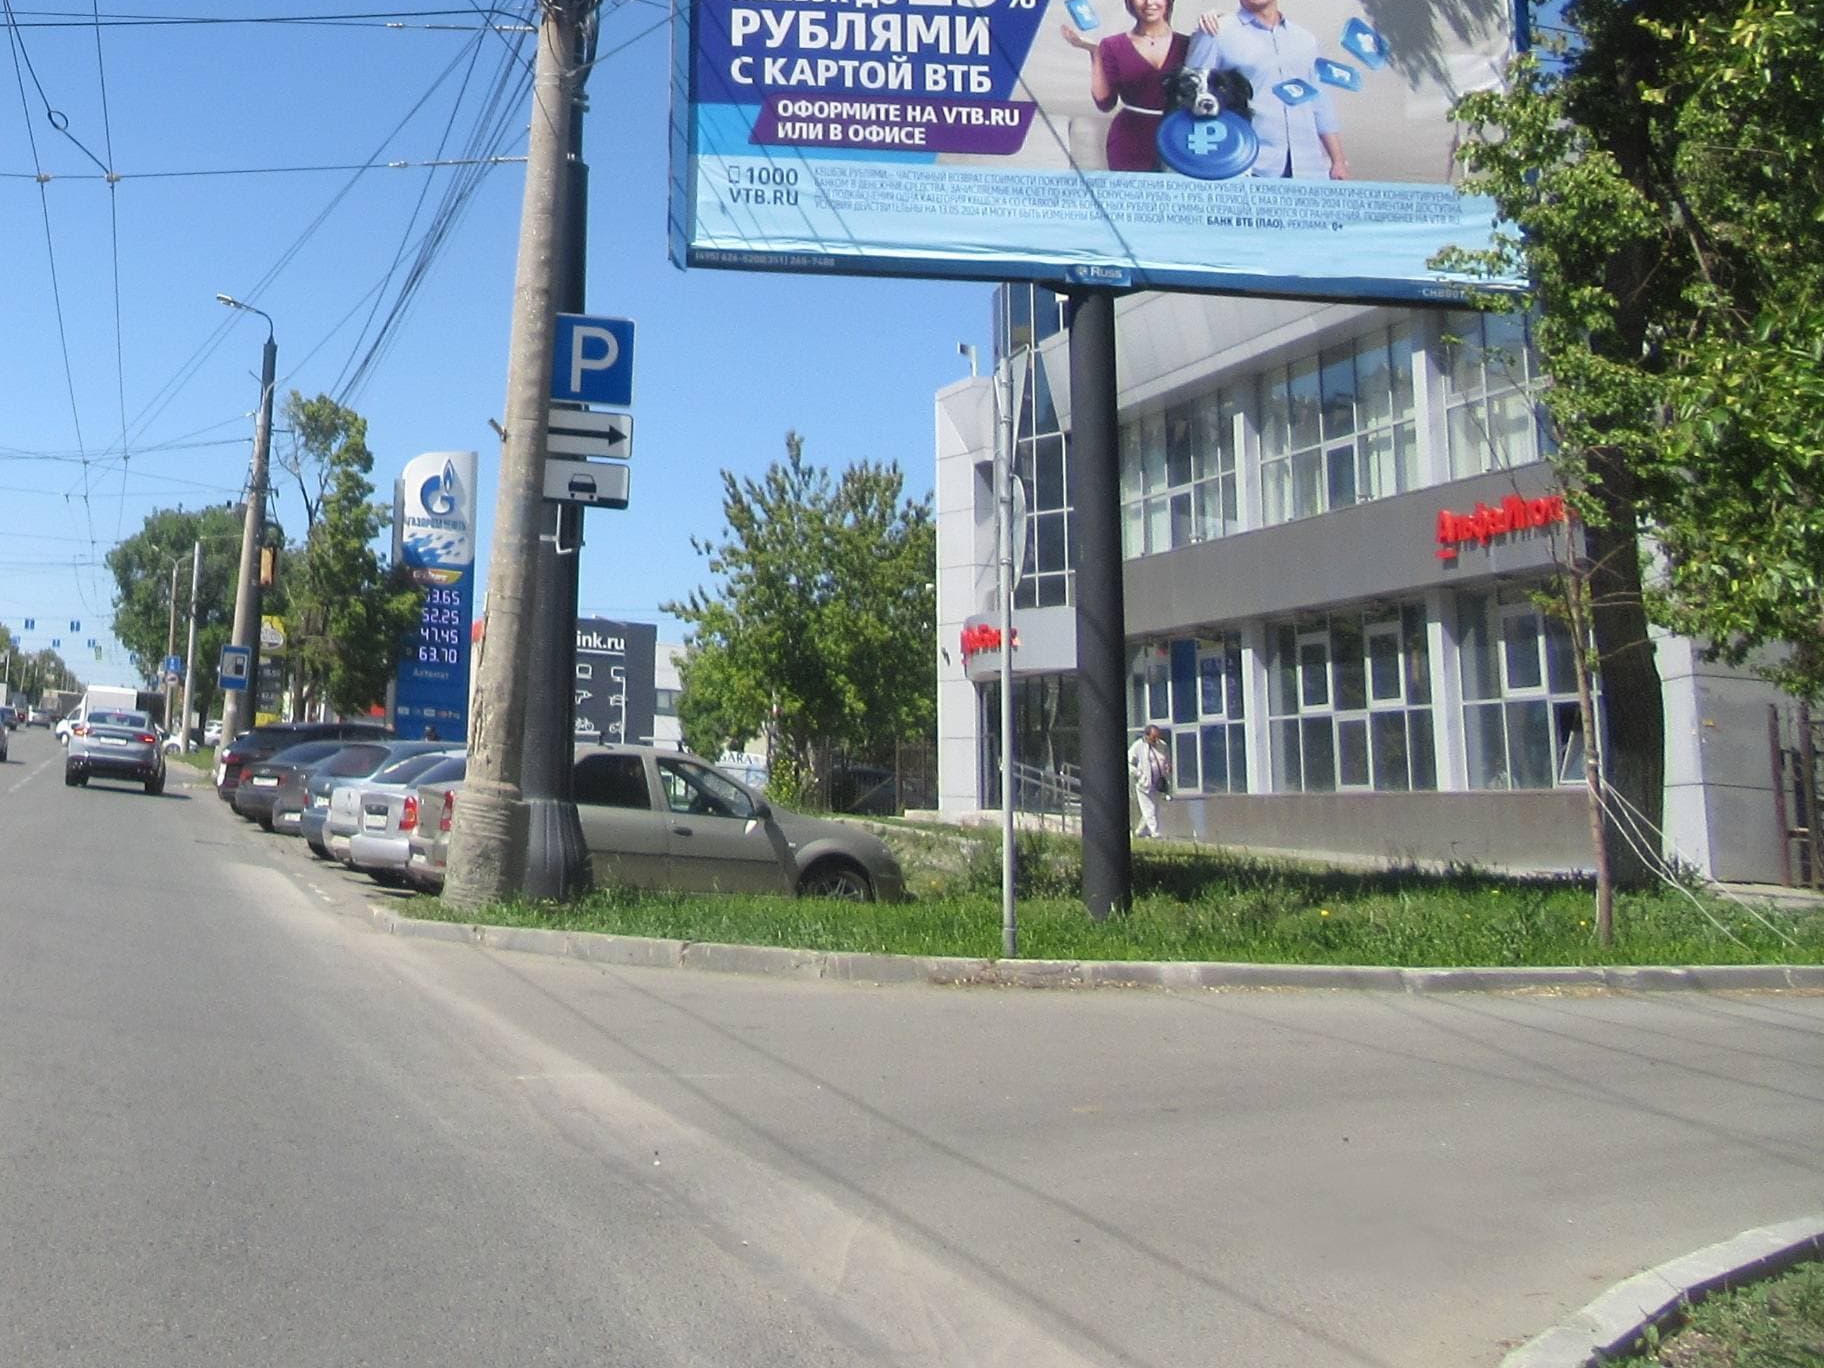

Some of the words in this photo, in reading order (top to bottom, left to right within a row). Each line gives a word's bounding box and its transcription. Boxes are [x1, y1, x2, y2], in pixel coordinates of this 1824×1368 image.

[731, 8, 990, 56] РУБЛЯМИ
[730, 56, 753, 84] С
[764, 55, 913, 90] КАРТОЙ
[925, 63, 992, 93] ВТБ
[777, 100, 900, 121] ОФОРМИТЕ
[908, 106, 937, 123] НА
[942, 106, 1020, 126] VTB.RU
[777, 122, 823, 141] ИЛИ
[829, 124, 843, 141] В
[848, 124, 927, 144] ОФИСЕ
[746, 167, 799, 186] 1000
[729, 187, 799, 206] VTB.RU
[1207, 215, 1232, 226] БАНК
[1236, 217, 1253, 227] ВТБ
[570, 326, 619, 393] P
[576, 631, 625, 650] ink.ru
[418, 646, 457, 664] 63.70
